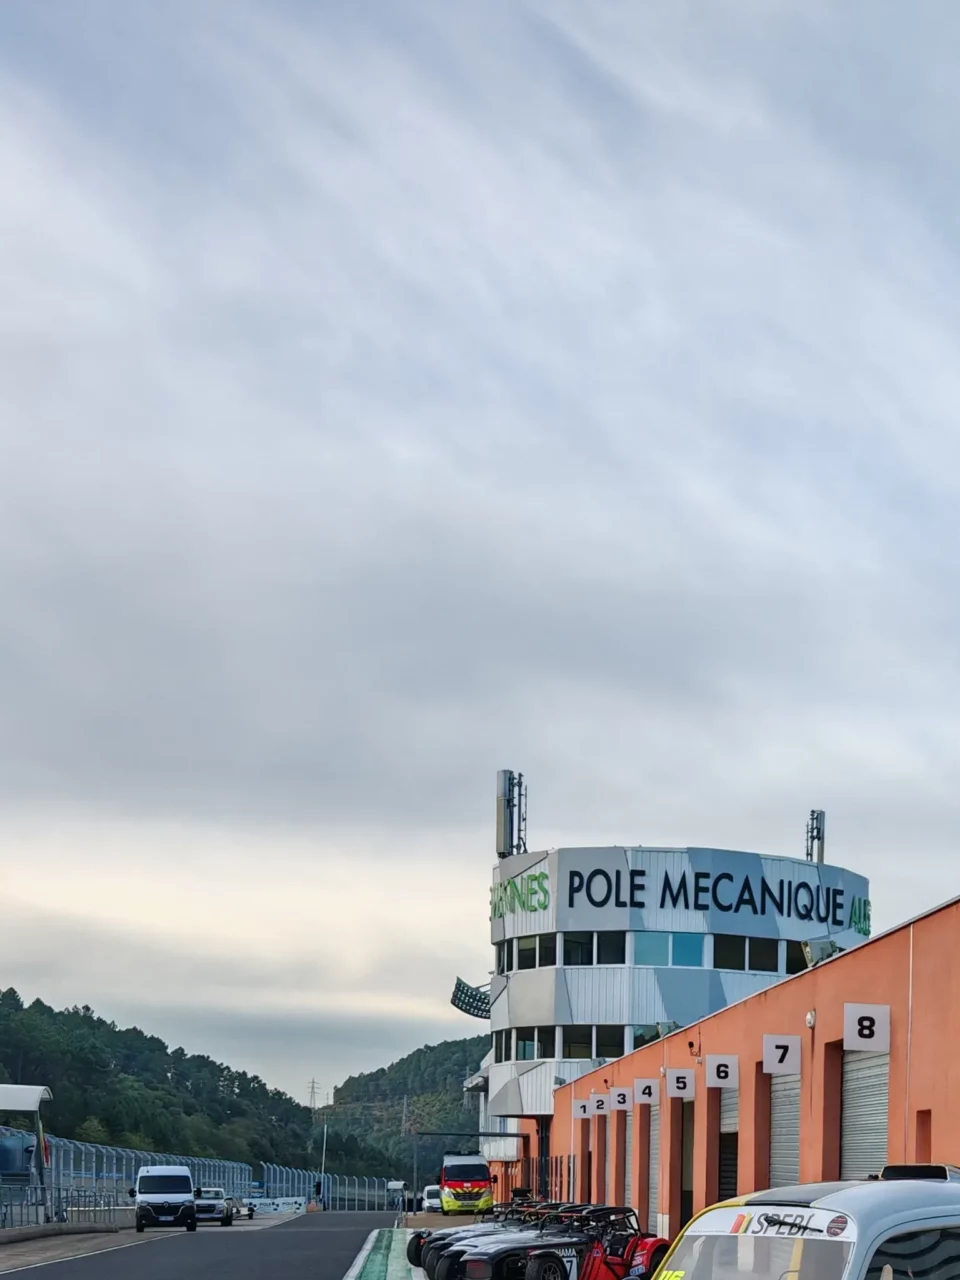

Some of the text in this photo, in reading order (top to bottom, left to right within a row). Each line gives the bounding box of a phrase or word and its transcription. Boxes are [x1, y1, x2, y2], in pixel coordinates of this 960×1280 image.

[568, 868, 844, 927] POLE MECANIQUE
[857, 1016, 875, 1039] 8
[775, 1045, 789, 1064] 7
[716, 1064, 729, 1080] 6
[676, 1076, 687, 1090] 5
[617, 1093, 626, 1104] 3
[642, 1085, 652, 1097] 4
[580, 1104, 587, 1114] 1
[596, 1100, 604, 1110] 2
[752, 1213, 815, 1236] SPEBI
